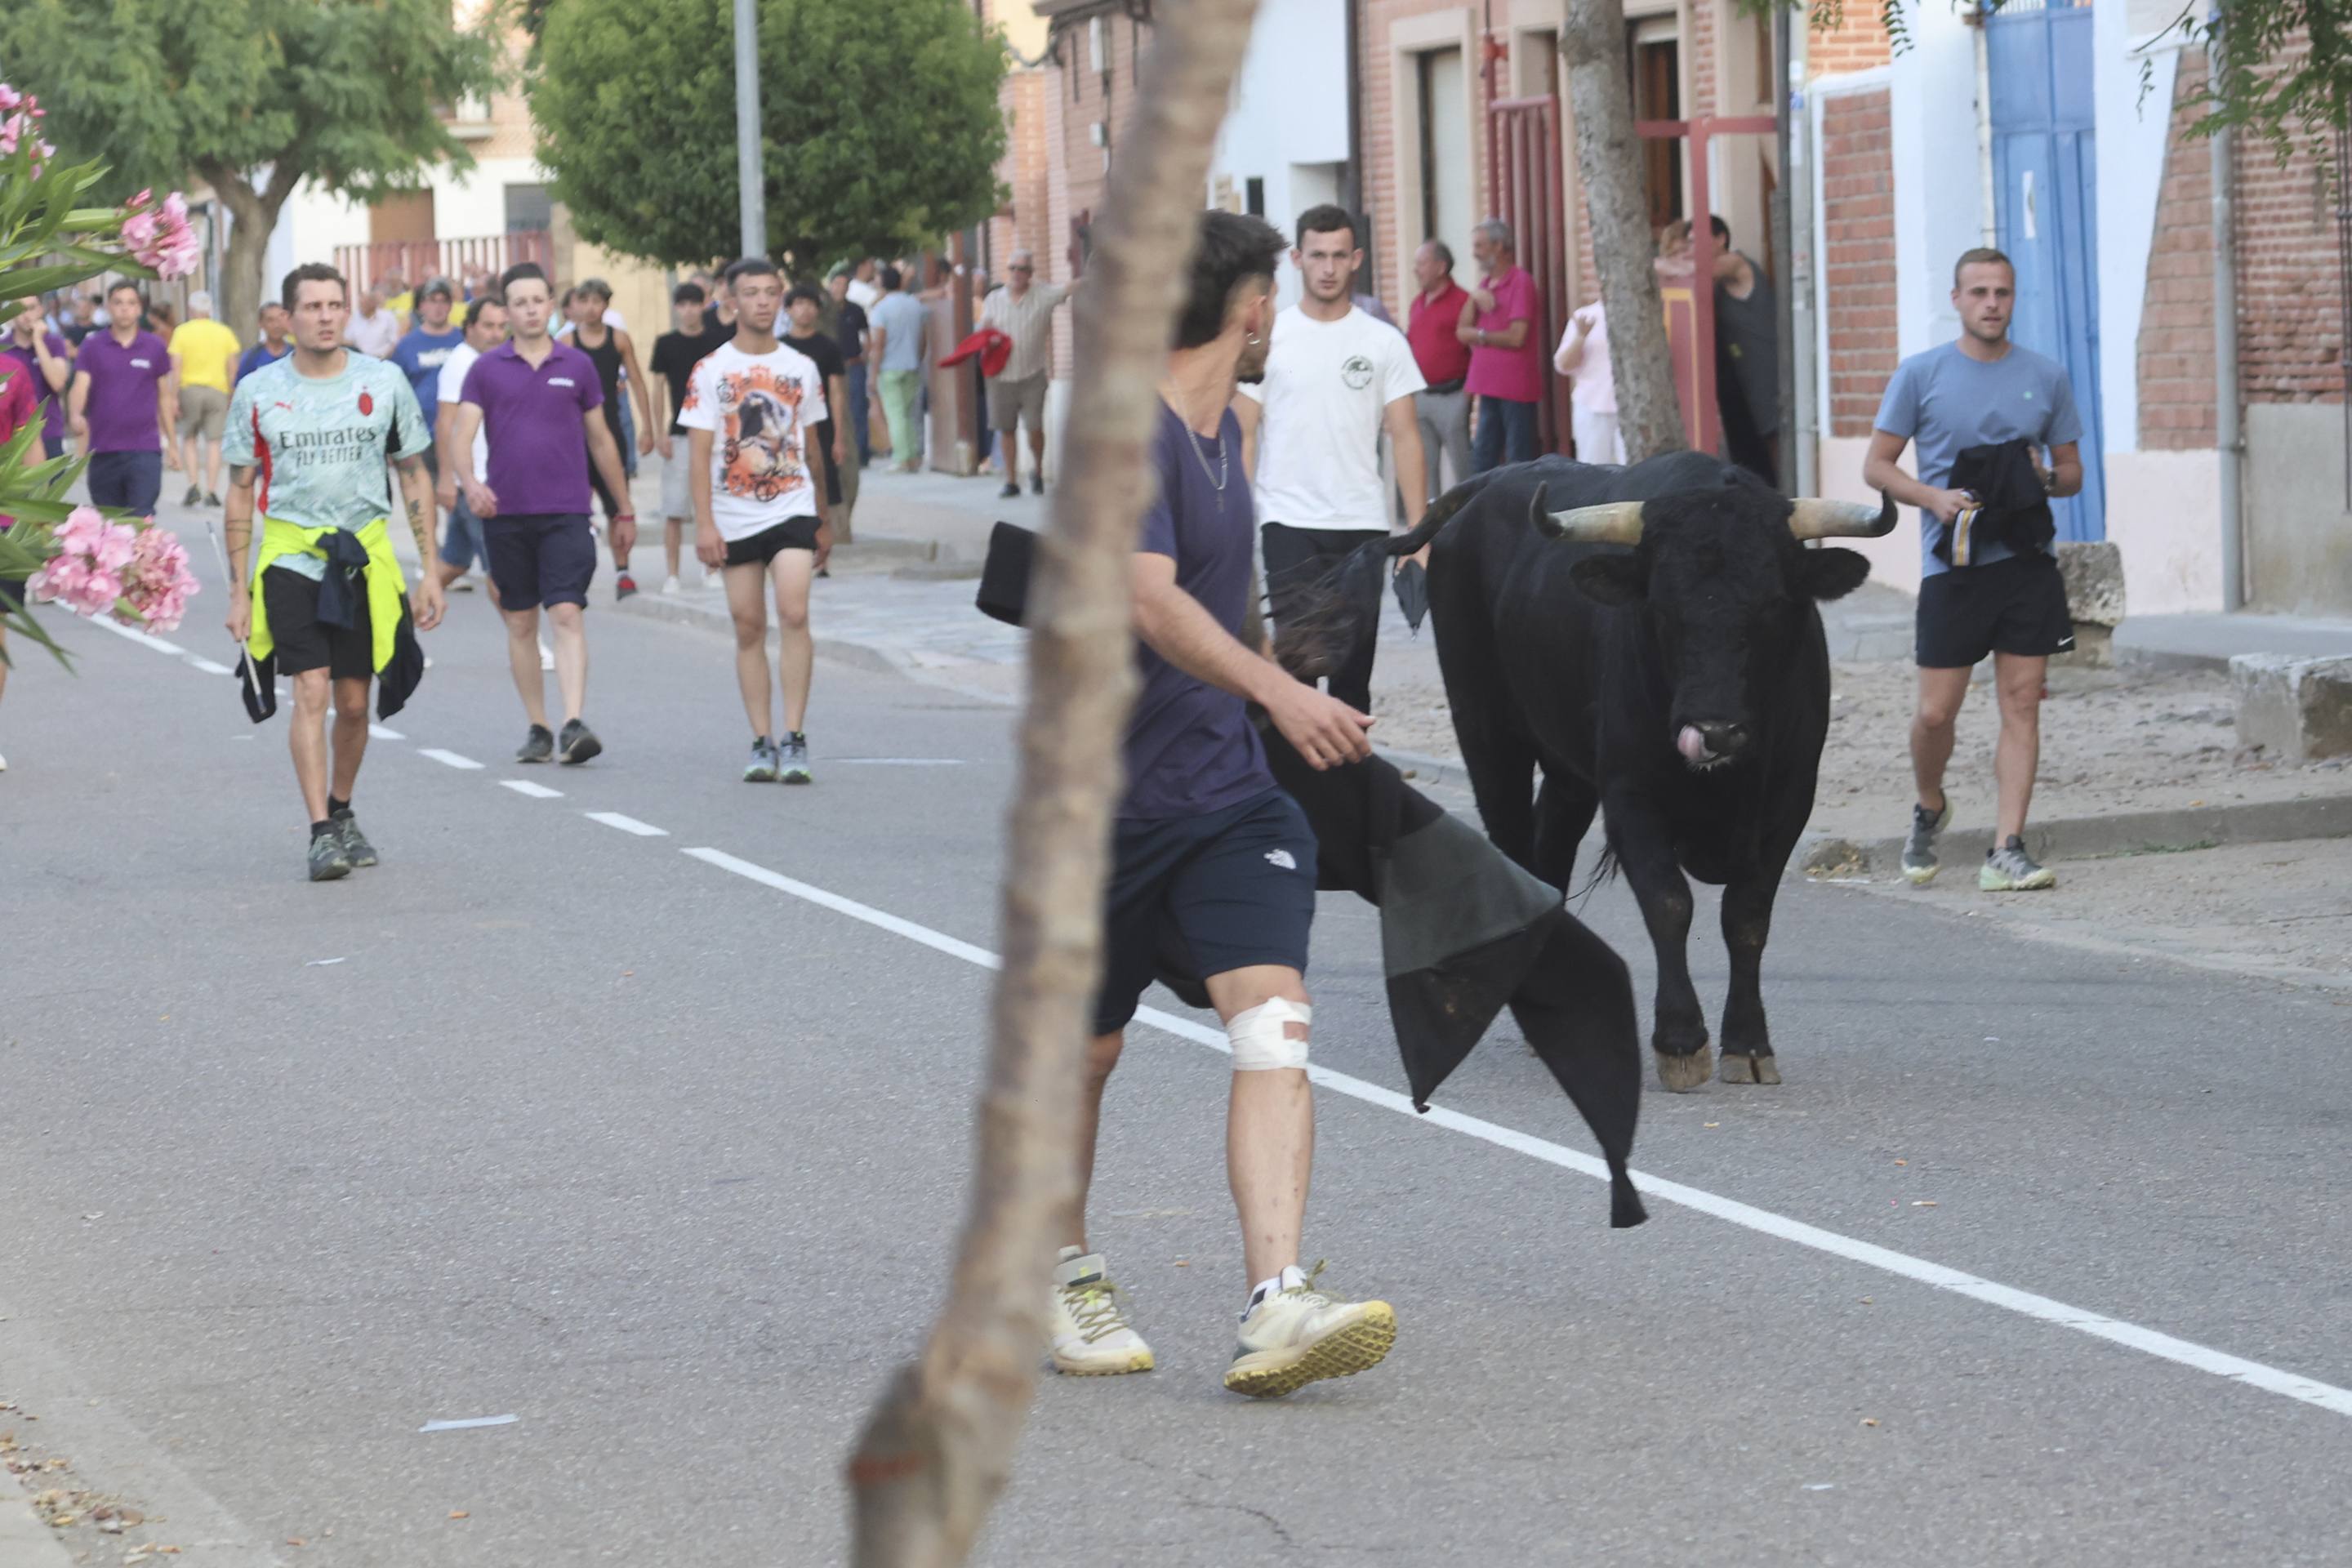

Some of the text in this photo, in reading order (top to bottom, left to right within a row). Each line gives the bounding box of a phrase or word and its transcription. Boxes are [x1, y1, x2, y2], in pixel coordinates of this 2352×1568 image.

[279, 426, 376, 449] Emirates
[296, 446, 363, 468] FLY BETTER
